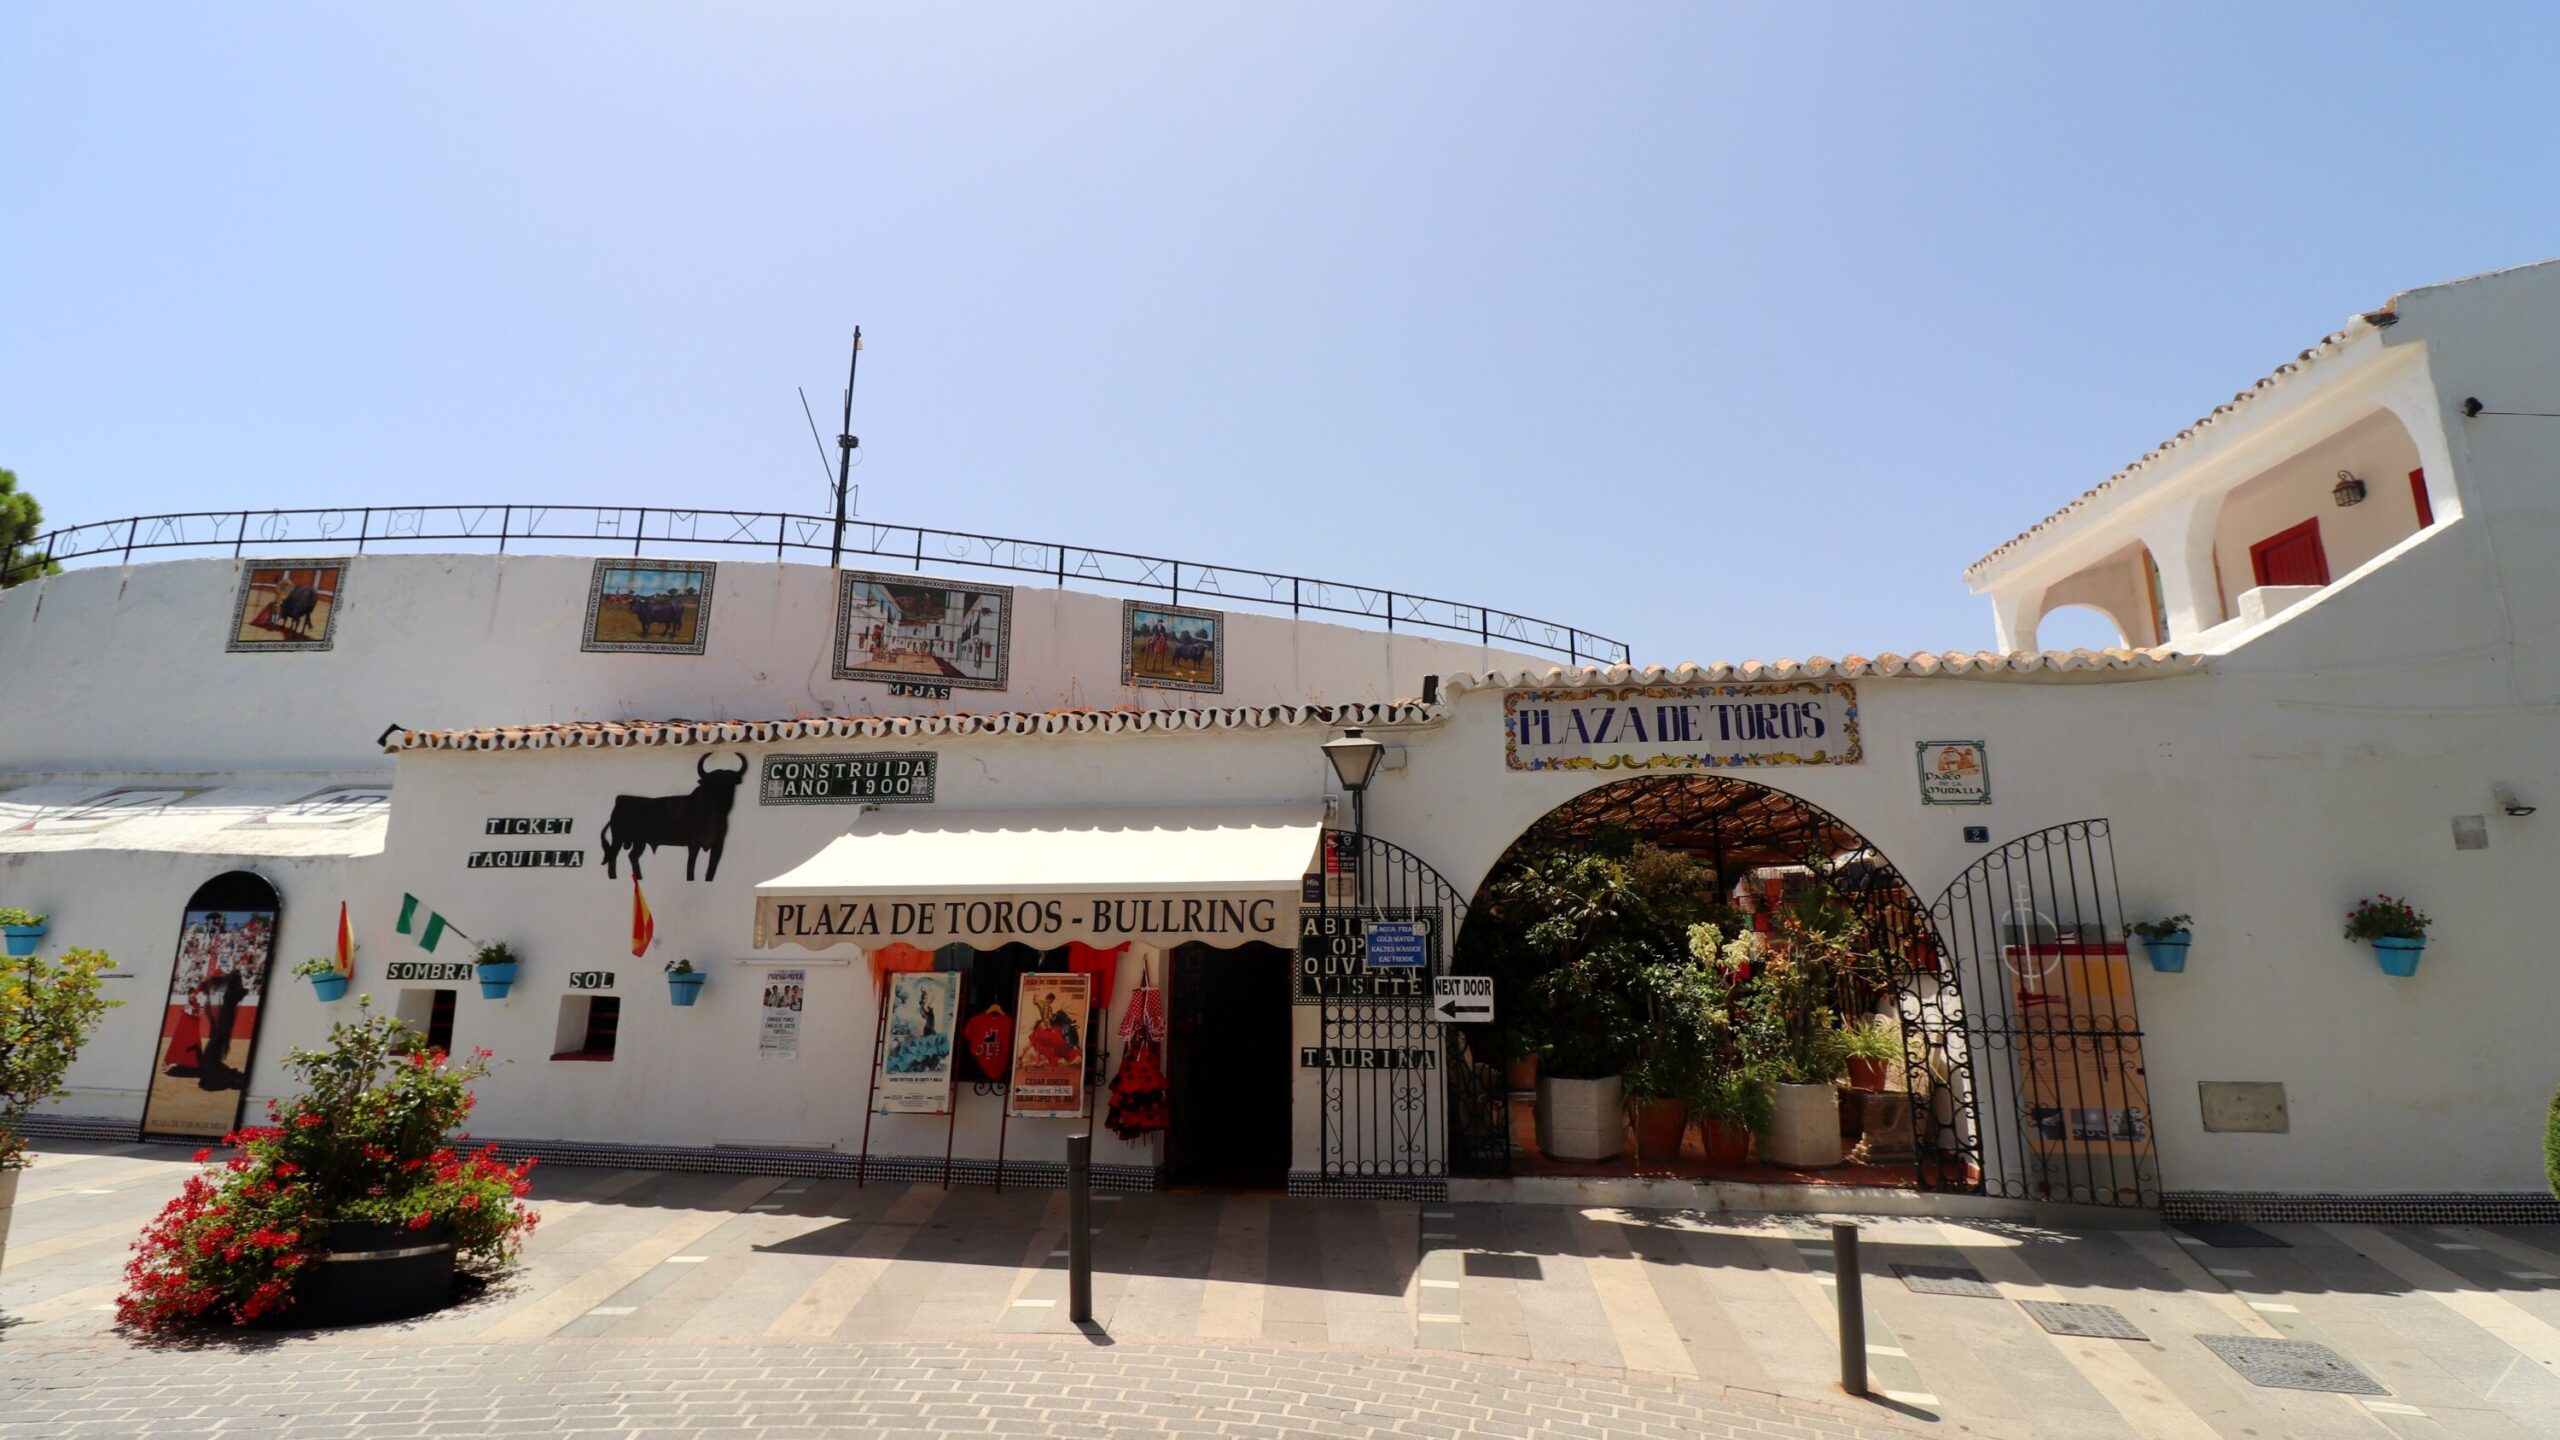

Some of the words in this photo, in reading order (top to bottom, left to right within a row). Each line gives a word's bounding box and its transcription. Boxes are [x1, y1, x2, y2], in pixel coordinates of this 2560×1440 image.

[1520, 706, 1649, 745] PLAZA
[1657, 705, 1702, 742] DE
[1711, 701, 1826, 741] TOROS
[771, 761, 926, 780] CONSTRUIDA
[851, 778, 910, 795] 1900
[487, 818, 572, 834] TICKET
[1972, 829, 1980, 841] 2
[469, 851, 583, 867] TAQUILLA
[776, 902, 880, 936] PLAZA
[891, 902, 935, 935] DE
[945, 899, 1063, 934] TOROS
[1092, 898, 1276, 933] BULLRING
[389, 963, 470, 980] SOMBRA
[571, 972, 613, 988] SOL
[1435, 980, 1462, 996] NEXT
[1464, 980, 1491, 996] DOOR
[1303, 1048, 1435, 1068] TAURINA
